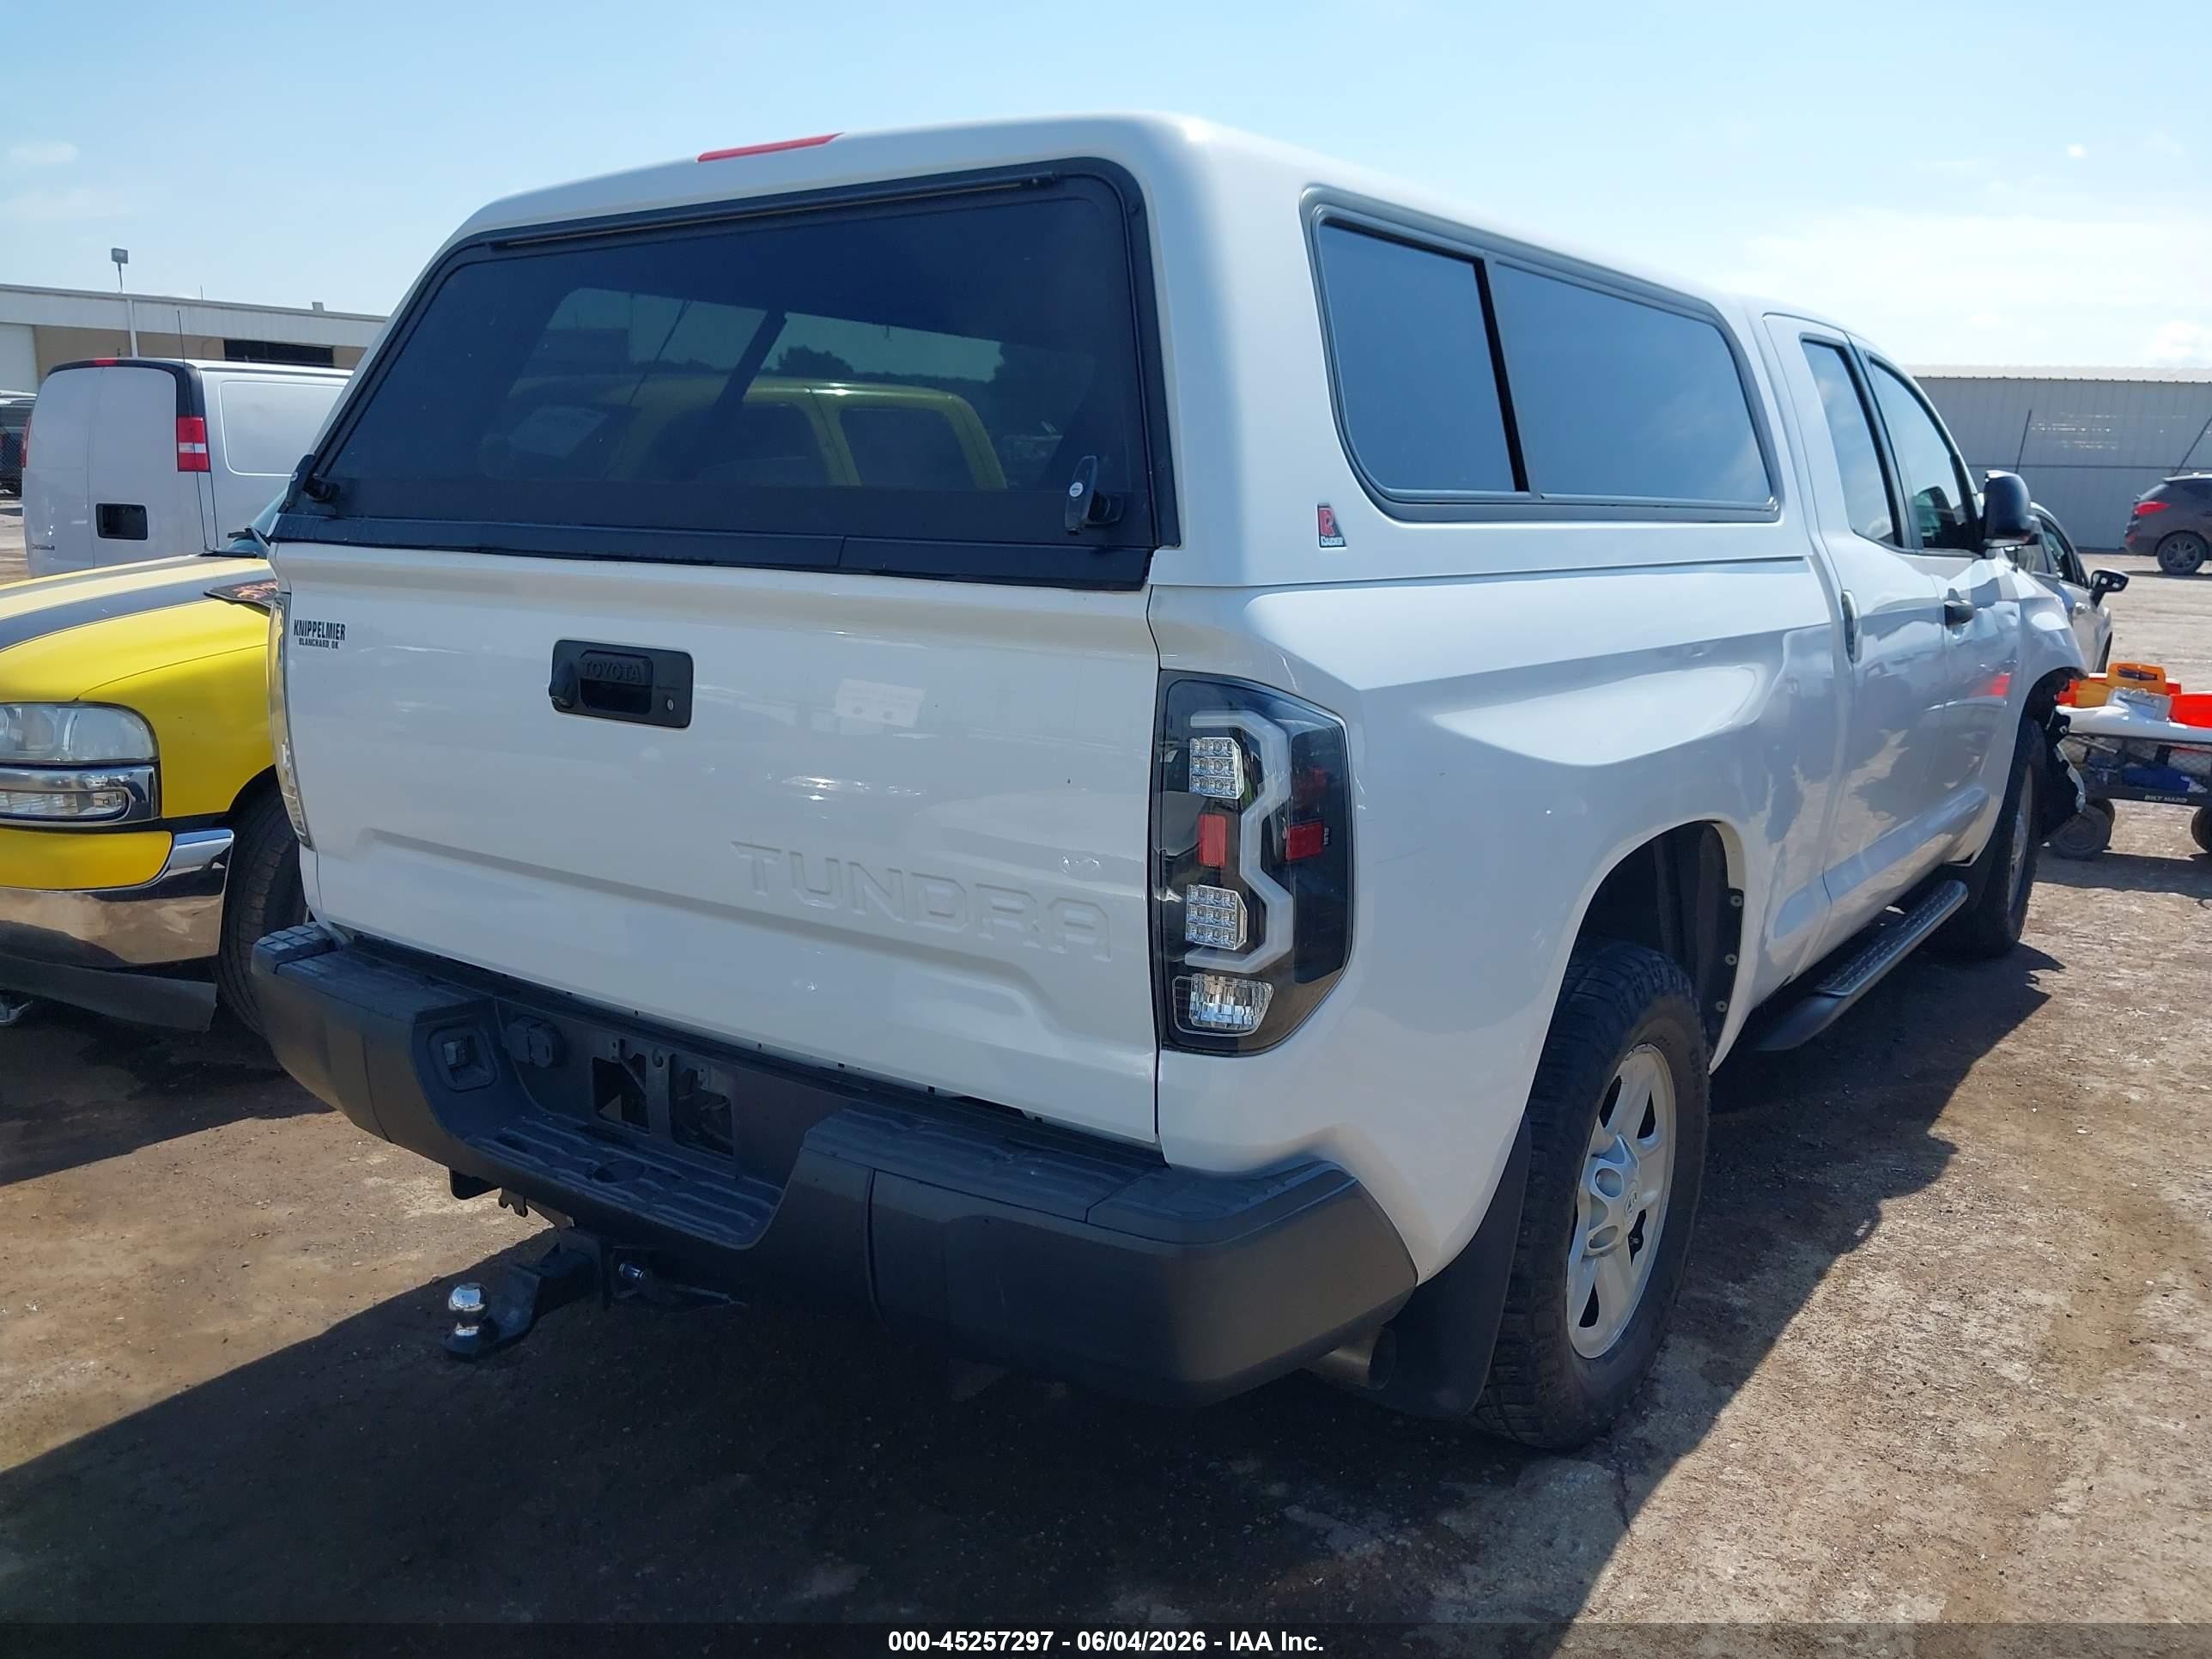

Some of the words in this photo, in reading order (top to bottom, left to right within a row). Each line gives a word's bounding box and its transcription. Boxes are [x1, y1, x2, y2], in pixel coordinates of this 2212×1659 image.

[293, 619, 346, 641] KNIPPELMIER
[331, 641, 340, 650] OK
[582, 659, 642, 682] TOYOTA
[730, 839, 1113, 963] TUNDRA
